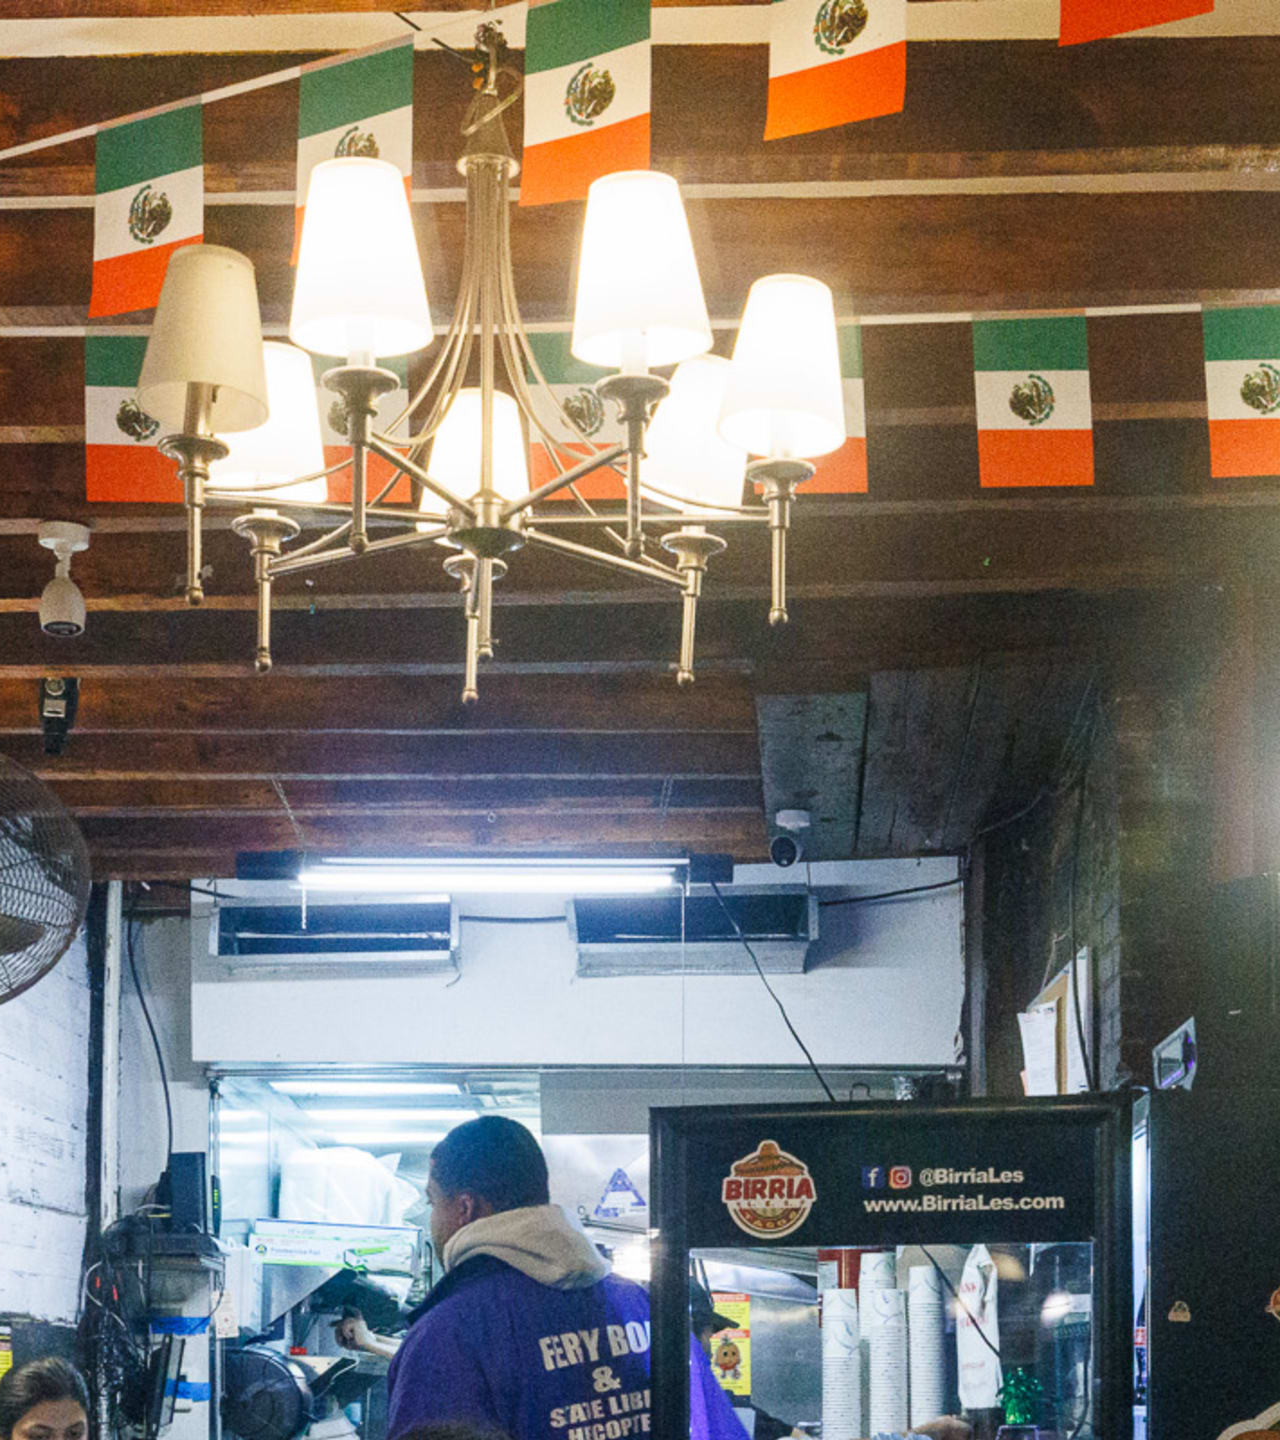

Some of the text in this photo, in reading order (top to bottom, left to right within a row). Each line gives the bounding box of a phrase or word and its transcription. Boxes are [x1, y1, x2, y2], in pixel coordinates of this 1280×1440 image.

[920, 1168, 1024, 1186] @BirriaLes
[724, 1178, 814, 1201] BIRRIA
[864, 1195, 1065, 1213] www.BirriaLes.com
[606, 1321, 650, 1357] BO
[592, 1365, 621, 1392] &
